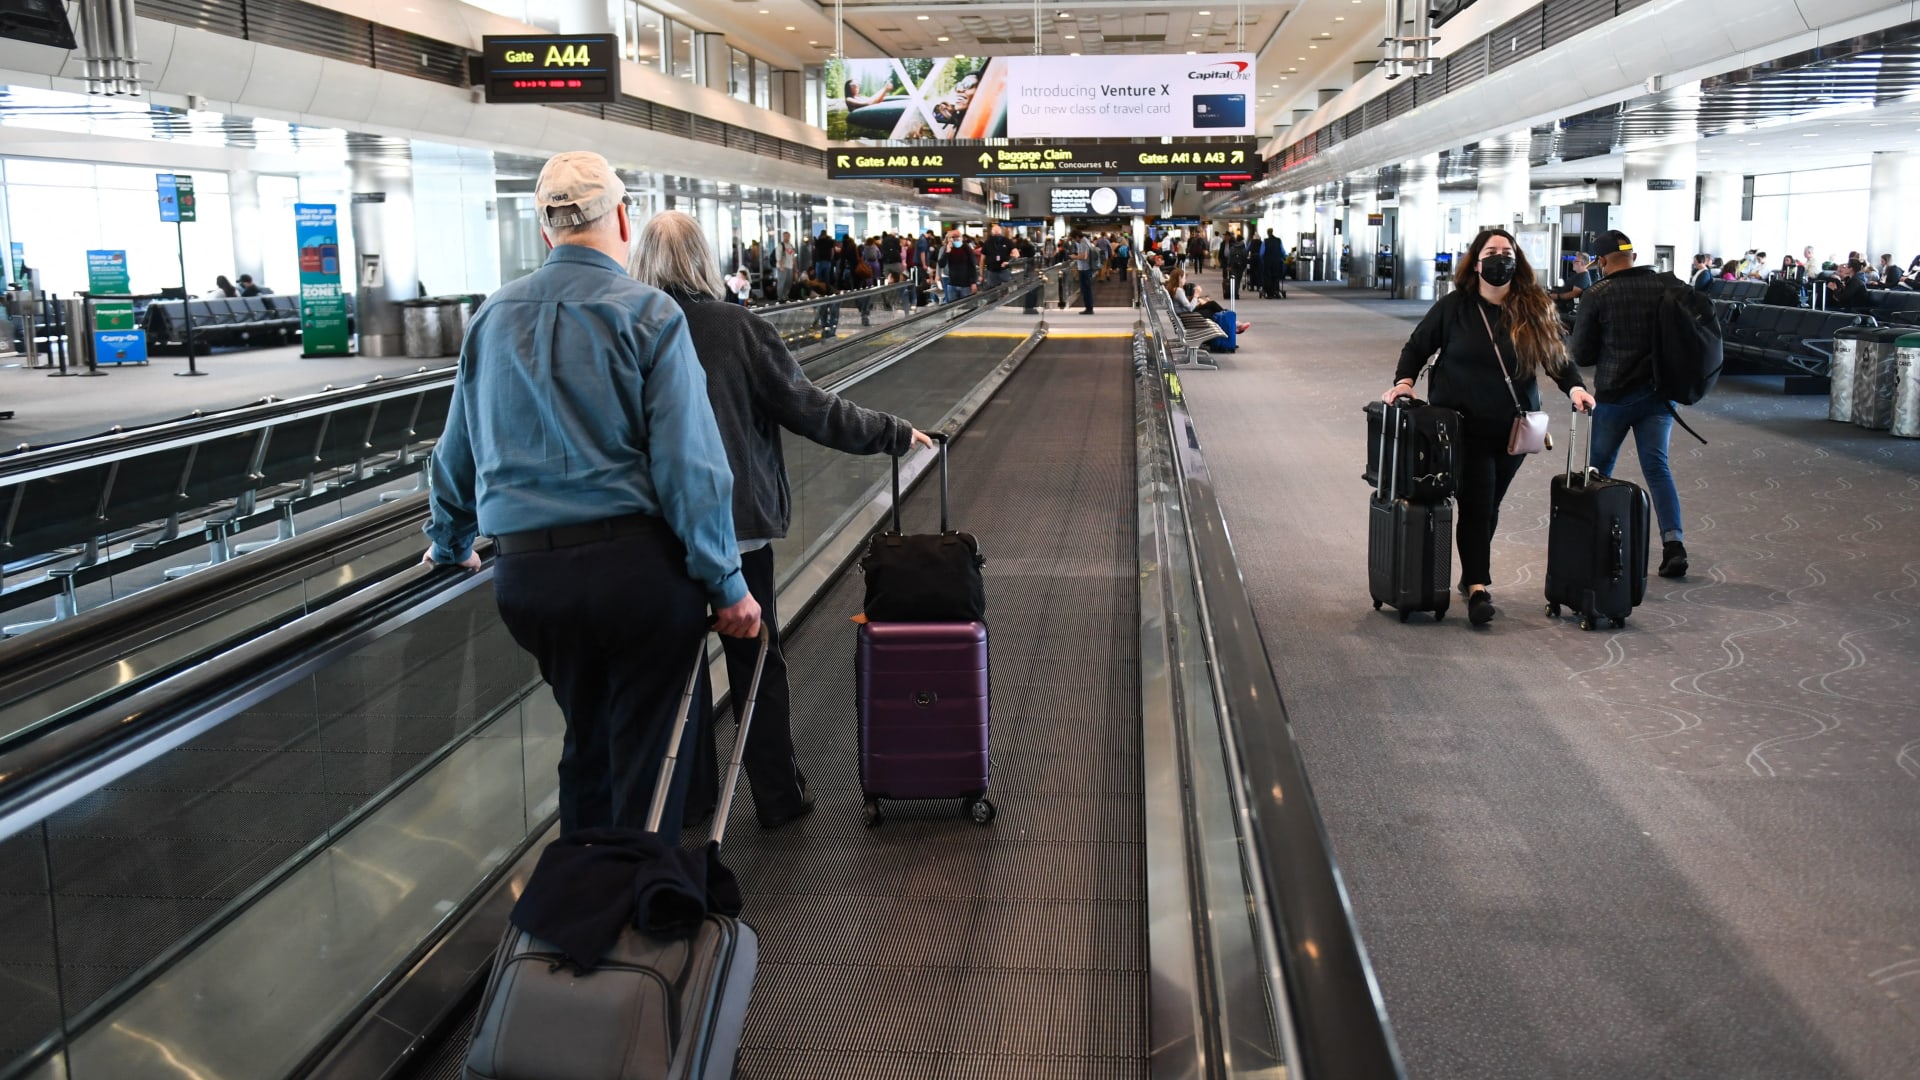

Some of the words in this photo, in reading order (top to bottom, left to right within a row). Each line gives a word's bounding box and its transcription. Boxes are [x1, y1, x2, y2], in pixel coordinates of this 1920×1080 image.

[505, 50, 534, 62] Gate
[544, 45, 590, 67] A44
[1021, 84, 1096, 100] Introducing
[1100, 84, 1156, 97] Venture
[1161, 84, 1170, 96] X
[1021, 104, 1041, 115] Our
[1044, 105, 1066, 114] new
[1070, 104, 1096, 114] class
[1100, 103, 1111, 114] of
[1113, 104, 1144, 114] travel
[1146, 103, 1171, 114] card
[855, 156, 885, 167] Gates
[888, 156, 908, 167] A40
[911, 156, 919, 167] &
[922, 156, 943, 167] A42
[998, 150, 1041, 162] Baggage
[1044, 149, 1072, 160] Claim
[1138, 153, 1168, 164] Gates
[1170, 152, 1190, 163] A41
[1192, 152, 1201, 163] &
[1204, 152, 1225, 163] A43
[998, 162, 1018, 170] Gates
[1051, 190, 1090, 198] UNICOIN
[302, 288, 335, 297] ZONE
